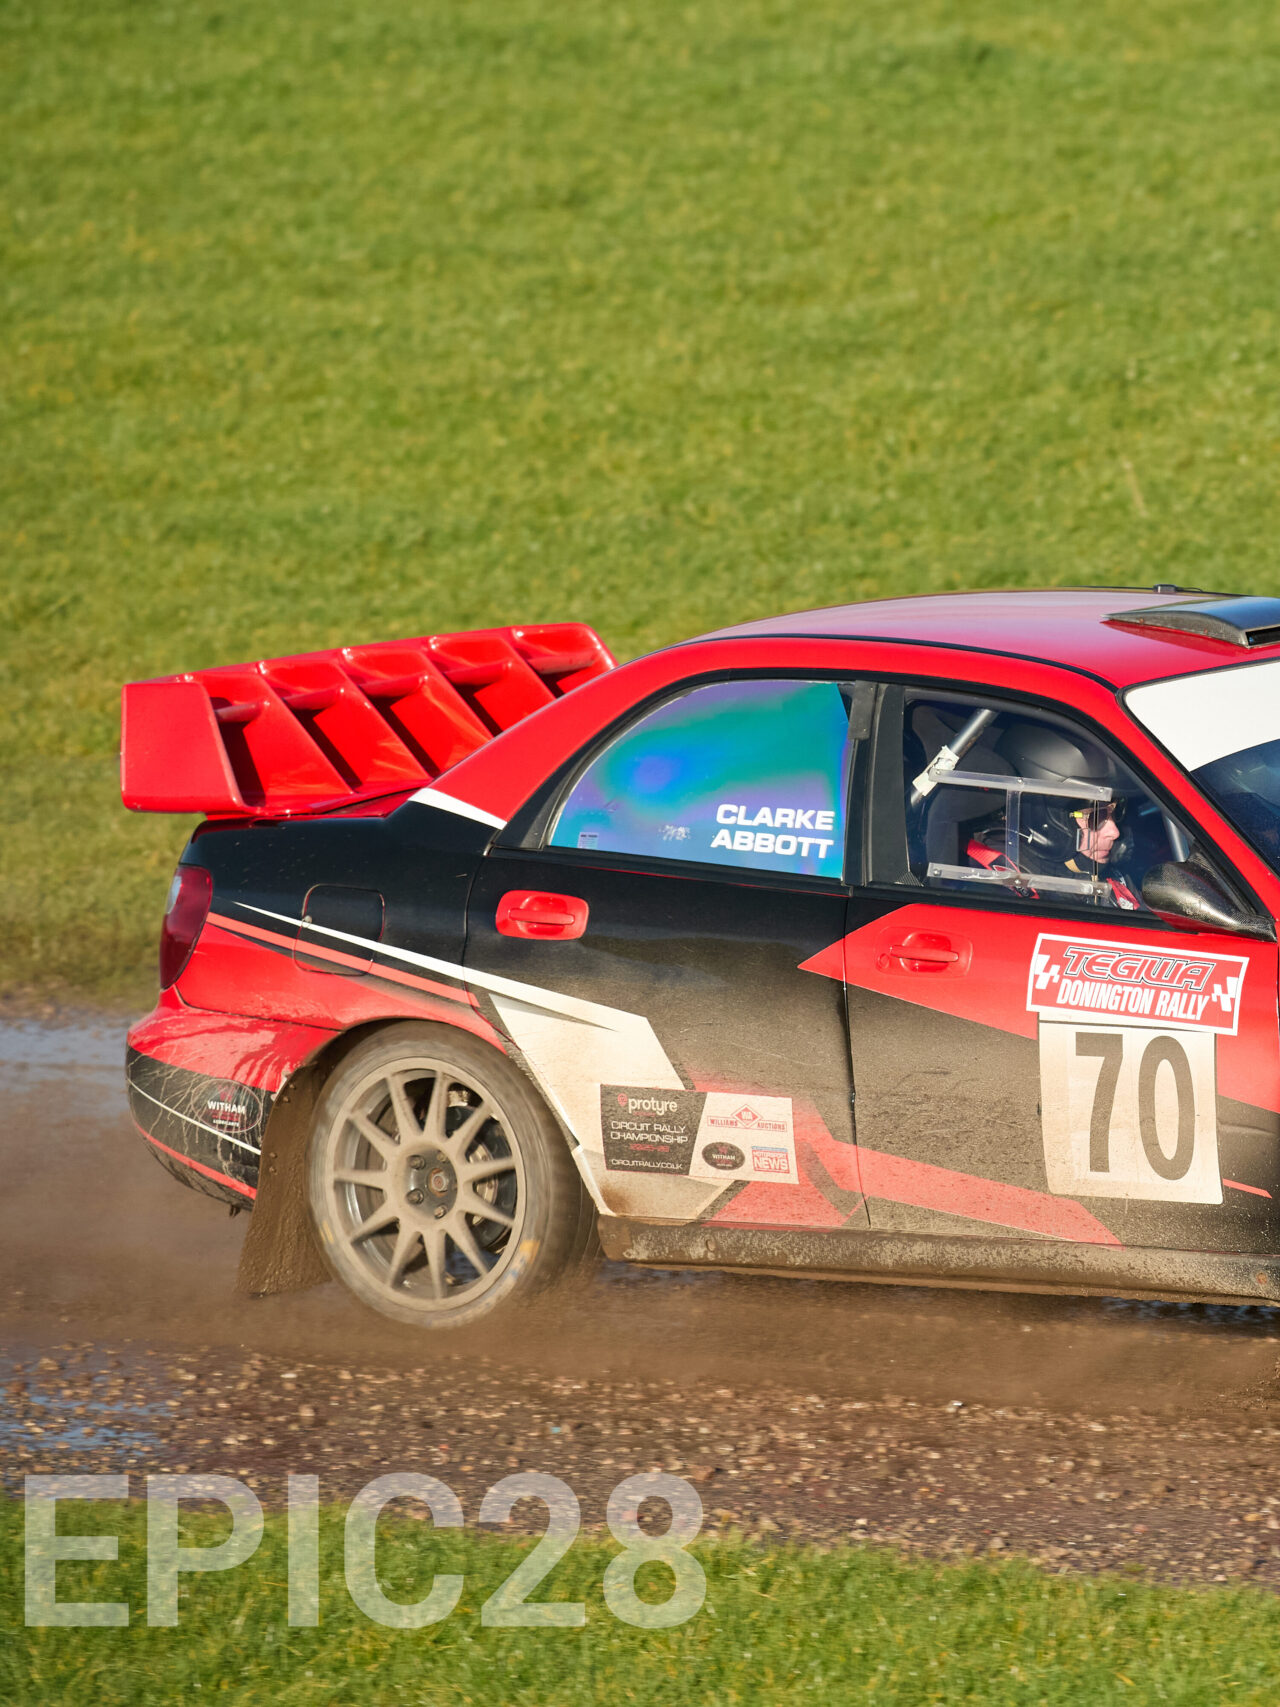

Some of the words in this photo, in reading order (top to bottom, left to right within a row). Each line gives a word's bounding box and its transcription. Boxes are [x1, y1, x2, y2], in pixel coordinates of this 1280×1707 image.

[716, 804, 835, 831] CLARKE
[710, 829, 834, 858] ABBOTT
[1063, 946, 1217, 991] TEGIWA
[1056, 979, 1153, 1014] DONINGTON
[1155, 990, 1211, 1021] RALLY
[207, 1100, 246, 1114] WITHAM
[628, 1097, 678, 1116] protyre
[1075, 1031, 1196, 1181] 70
[611, 1121, 651, 1131] CIRCUIT
[654, 1123, 686, 1133] RALLY
[710, 1119, 738, 1127] WILLIAMS
[757, 1122, 786, 1131] AUCTIONS
[610, 1131, 688, 1144] CHAMPIONSHIP
[712, 1153, 736, 1161] WITHAM
[753, 1157, 788, 1171] NEWS
